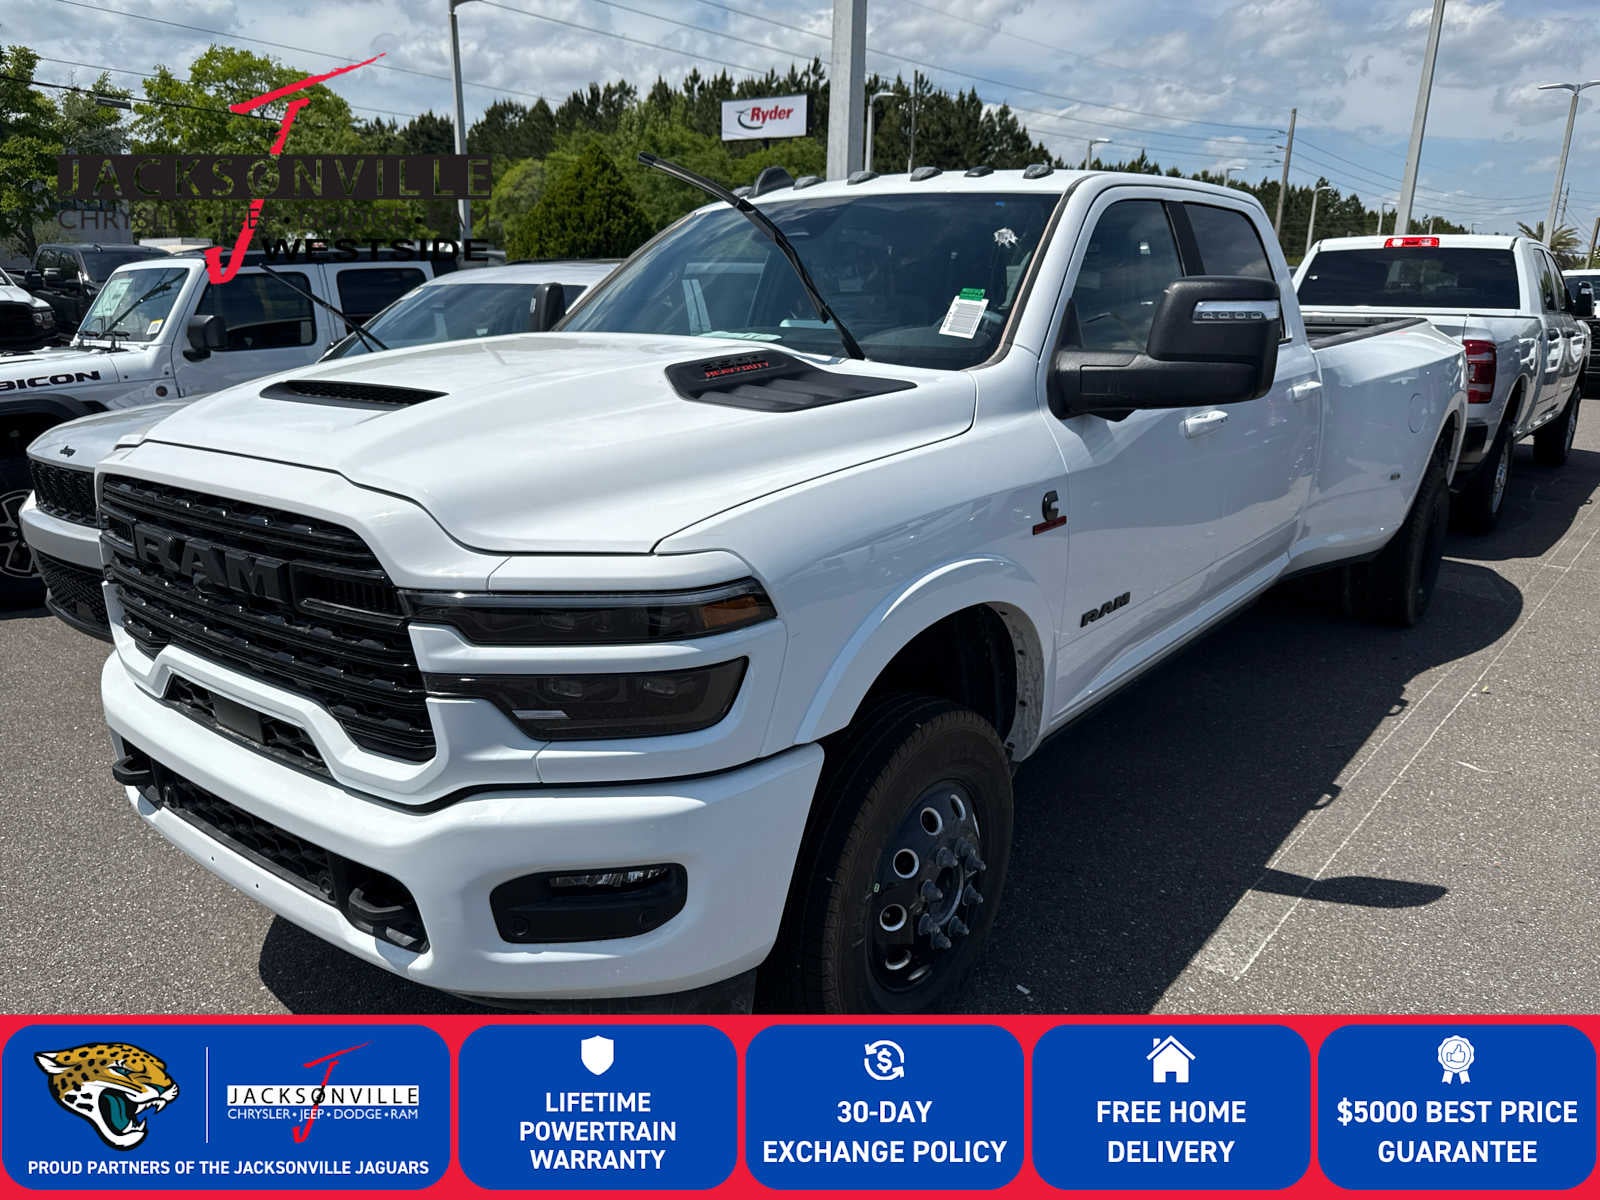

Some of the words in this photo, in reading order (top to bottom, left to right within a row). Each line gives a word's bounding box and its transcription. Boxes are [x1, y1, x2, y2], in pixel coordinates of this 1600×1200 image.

[750, 105, 794, 124] Ryder
[133, 523, 286, 604] RAM
[1079, 591, 1132, 628] RAM
